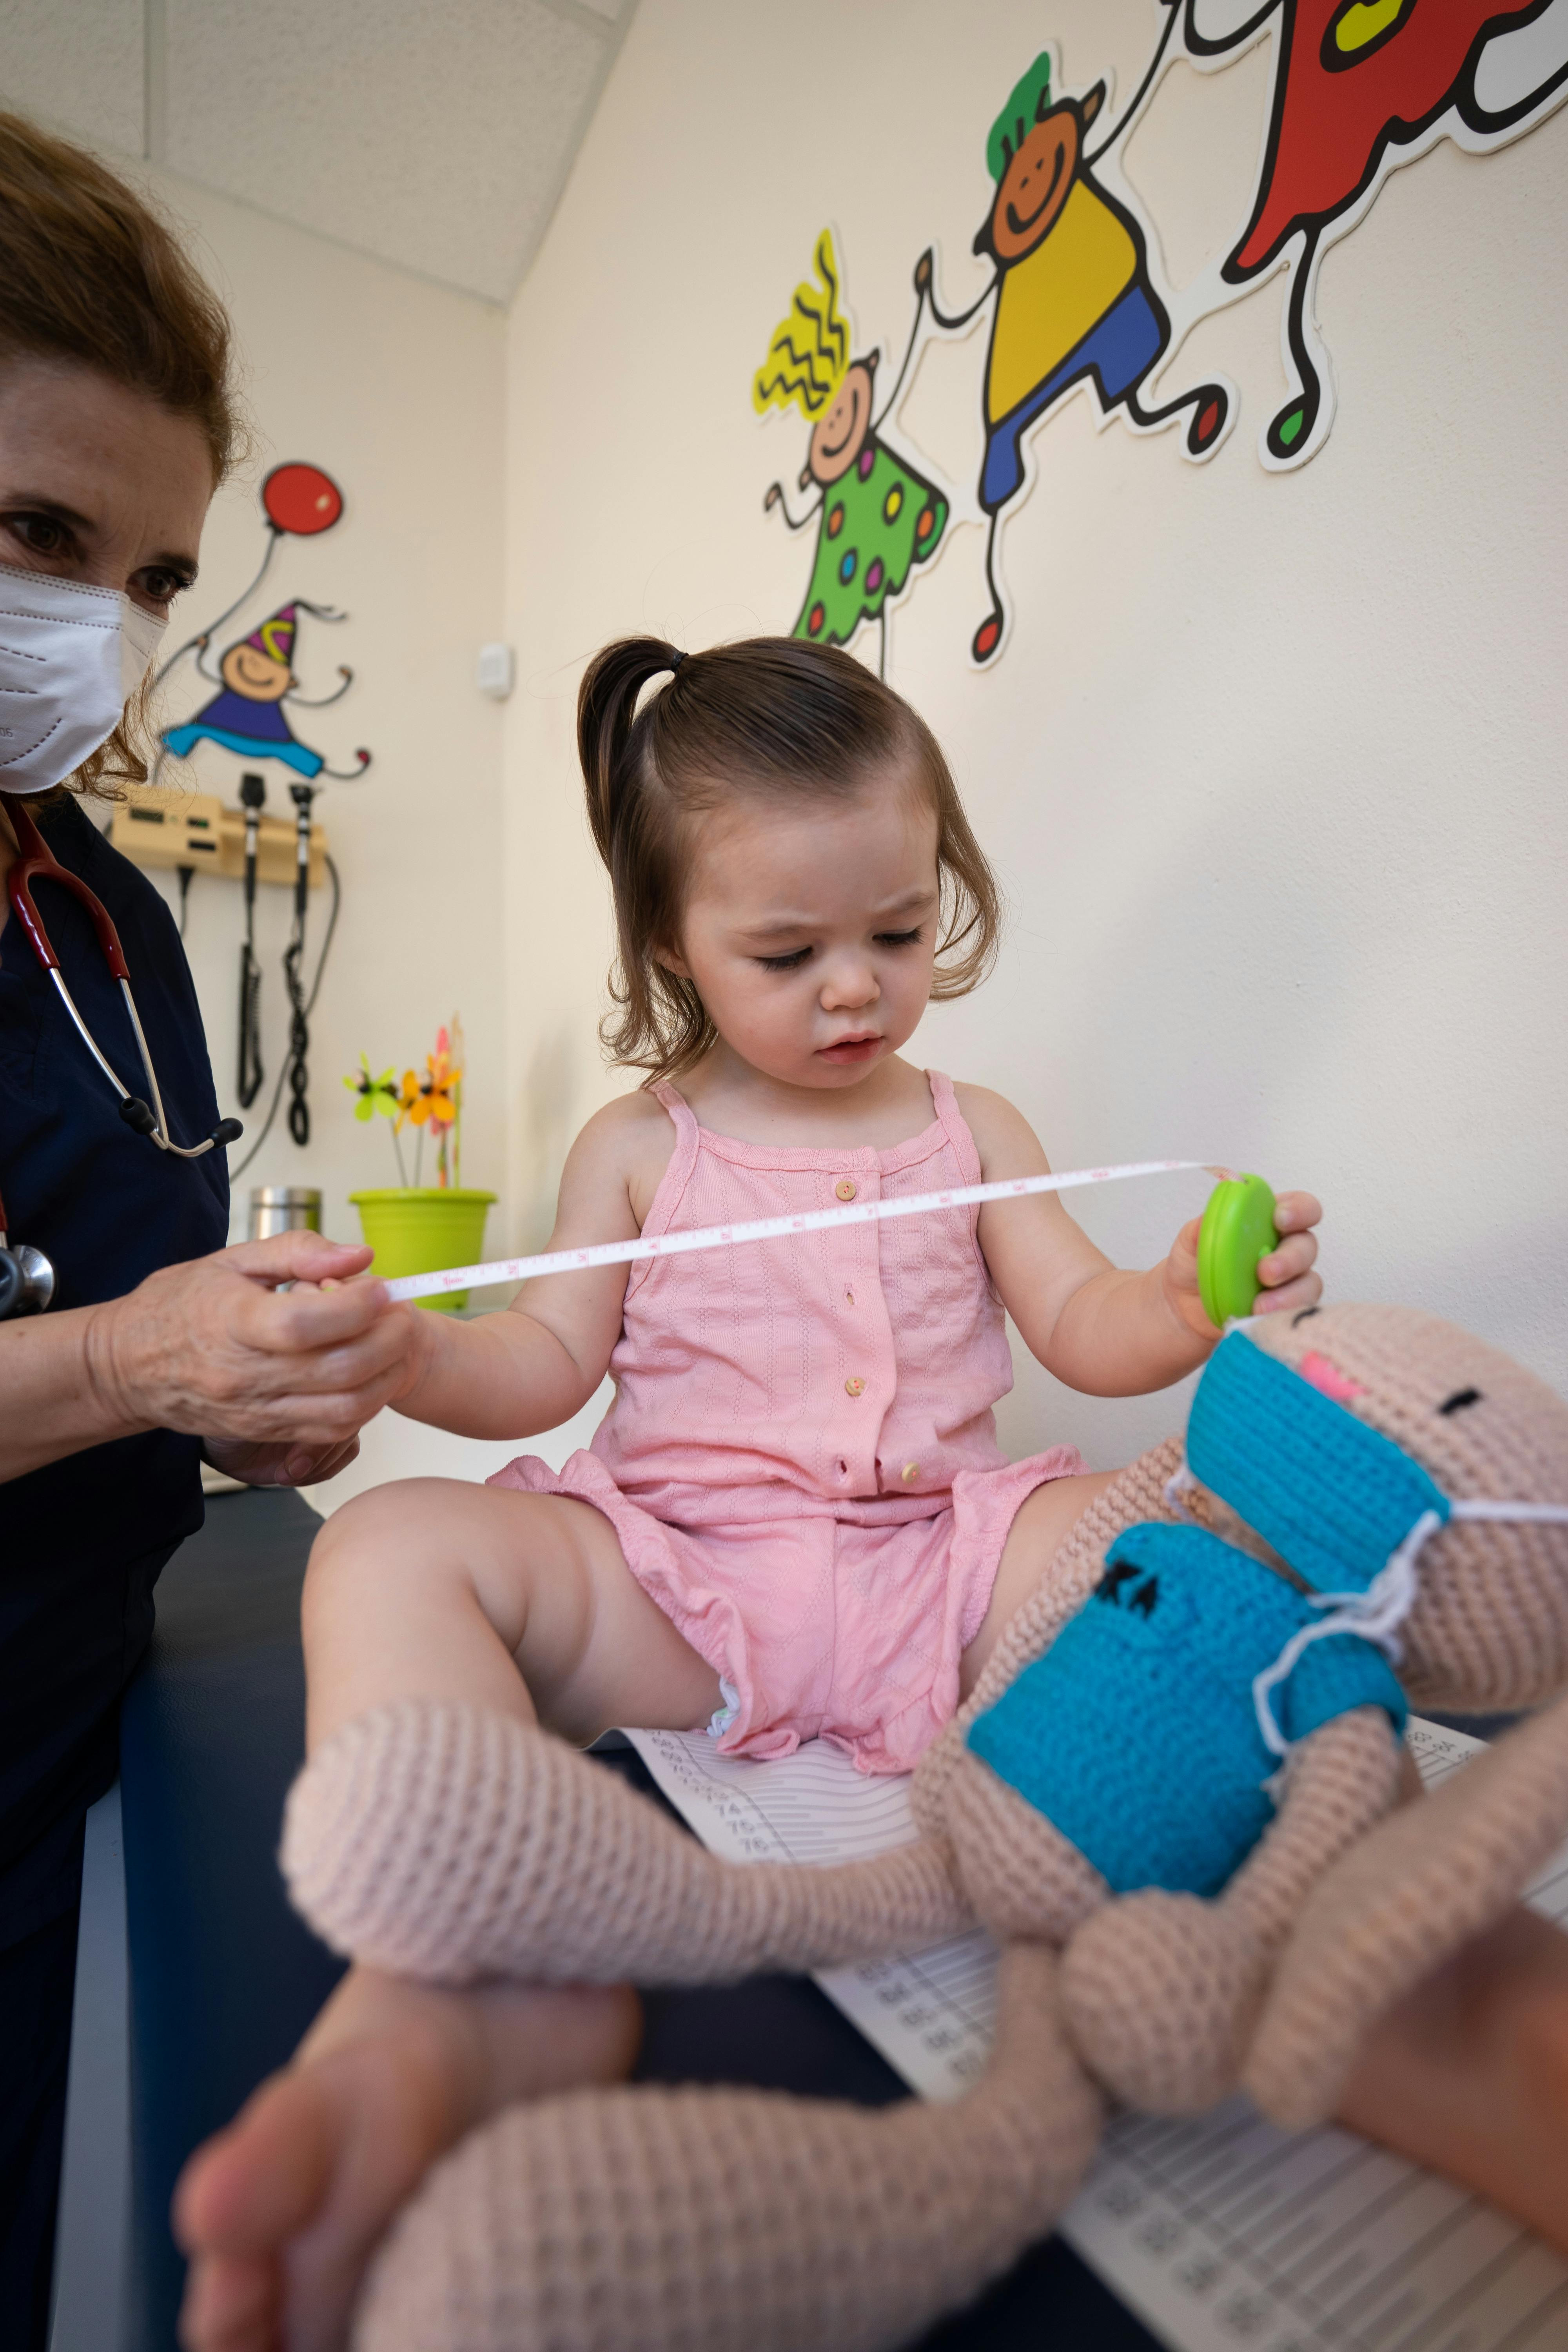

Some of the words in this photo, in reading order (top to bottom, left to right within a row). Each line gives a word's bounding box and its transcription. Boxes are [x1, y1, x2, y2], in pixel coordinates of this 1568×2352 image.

[713, 1802, 742, 1818] 74
[726, 1819, 755, 1836] 75
[738, 1837, 769, 1855] 76
